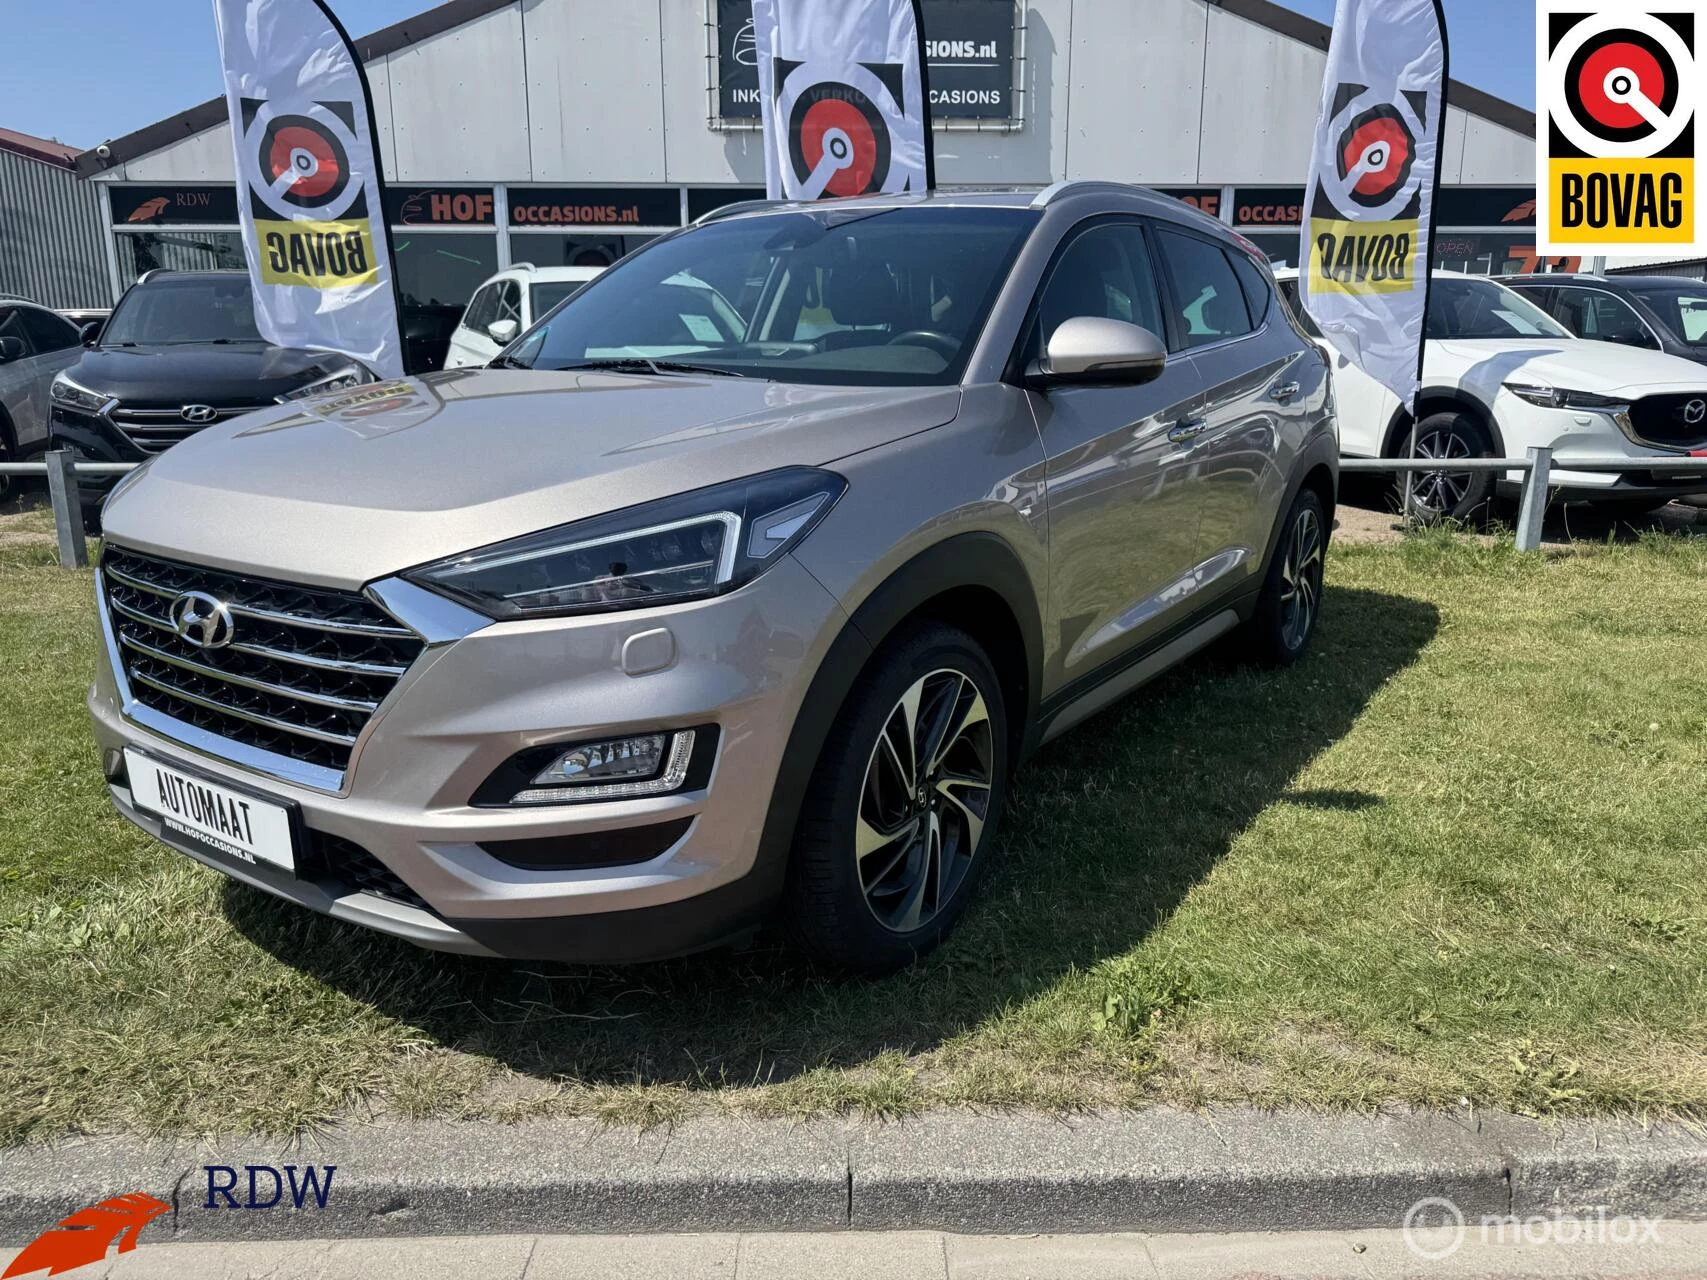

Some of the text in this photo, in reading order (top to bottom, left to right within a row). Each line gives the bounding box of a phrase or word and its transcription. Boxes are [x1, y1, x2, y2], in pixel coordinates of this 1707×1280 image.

[733, 88, 760, 103] INK
[929, 90, 1000, 104] CASIONS
[176, 192, 211, 206] RDW
[430, 194, 640, 222] HOF OCCASIONS.nl
[1436, 240, 1473, 255] OPEN
[156, 768, 254, 845] AUTOMAAT
[163, 817, 257, 865] WWW.HOFOCCASIONS.NL
